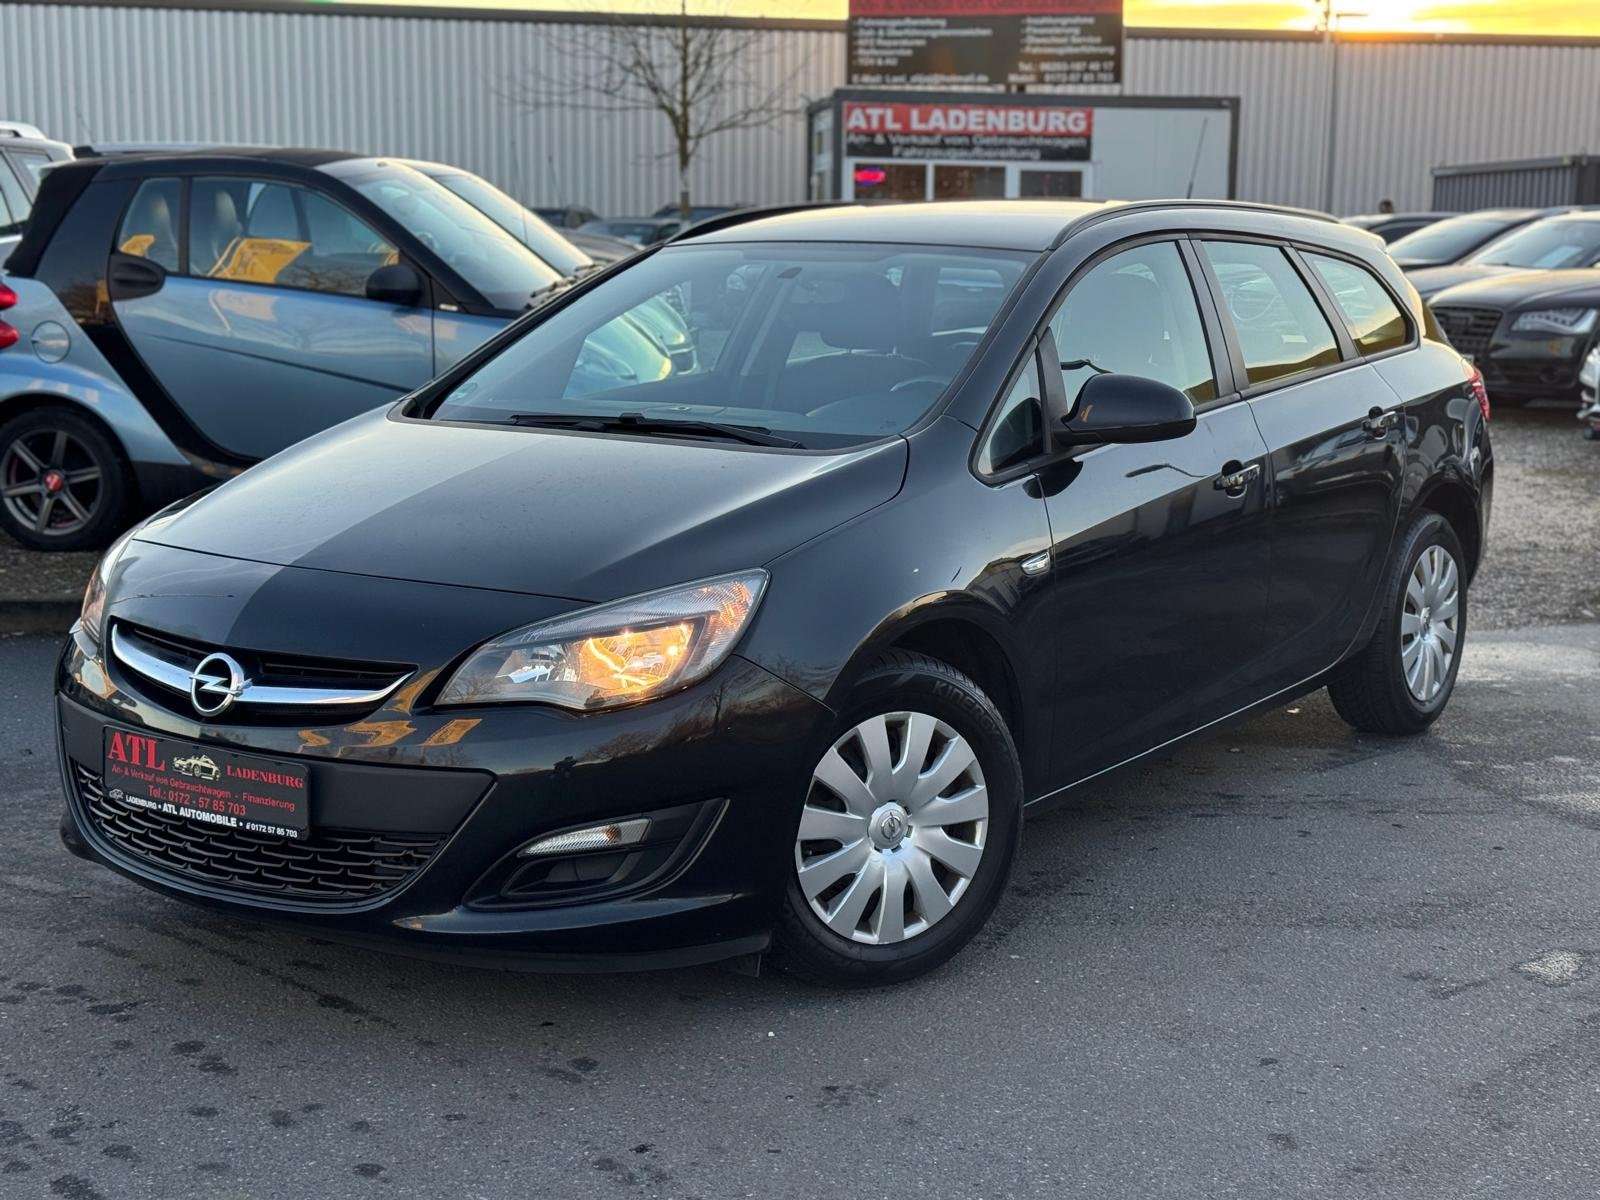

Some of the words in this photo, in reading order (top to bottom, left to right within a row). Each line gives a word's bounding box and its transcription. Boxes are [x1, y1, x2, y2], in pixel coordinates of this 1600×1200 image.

[847, 107, 902, 130] ATL
[909, 108, 1087, 132] LADENBURG
[108, 731, 166, 772] ATL
[225, 765, 304, 789] LADENBURG
[168, 790, 191, 805] 0172
[198, 797, 211, 810] 57
[212, 799, 225, 813] 85
[227, 801, 247, 816] 703
[169, 778, 232, 799] Gebrauchtwagen
[242, 792, 296, 813] Finanzierung
[125, 794, 157, 810] LADENBURG
[162, 802, 178, 815] ATL
[179, 806, 238, 828] AUTOMOBILE
[251, 823, 267, 833] 0172
[267, 825, 276, 834] 57
[276, 827, 285, 836] 85
[285, 828, 298, 838] 703
